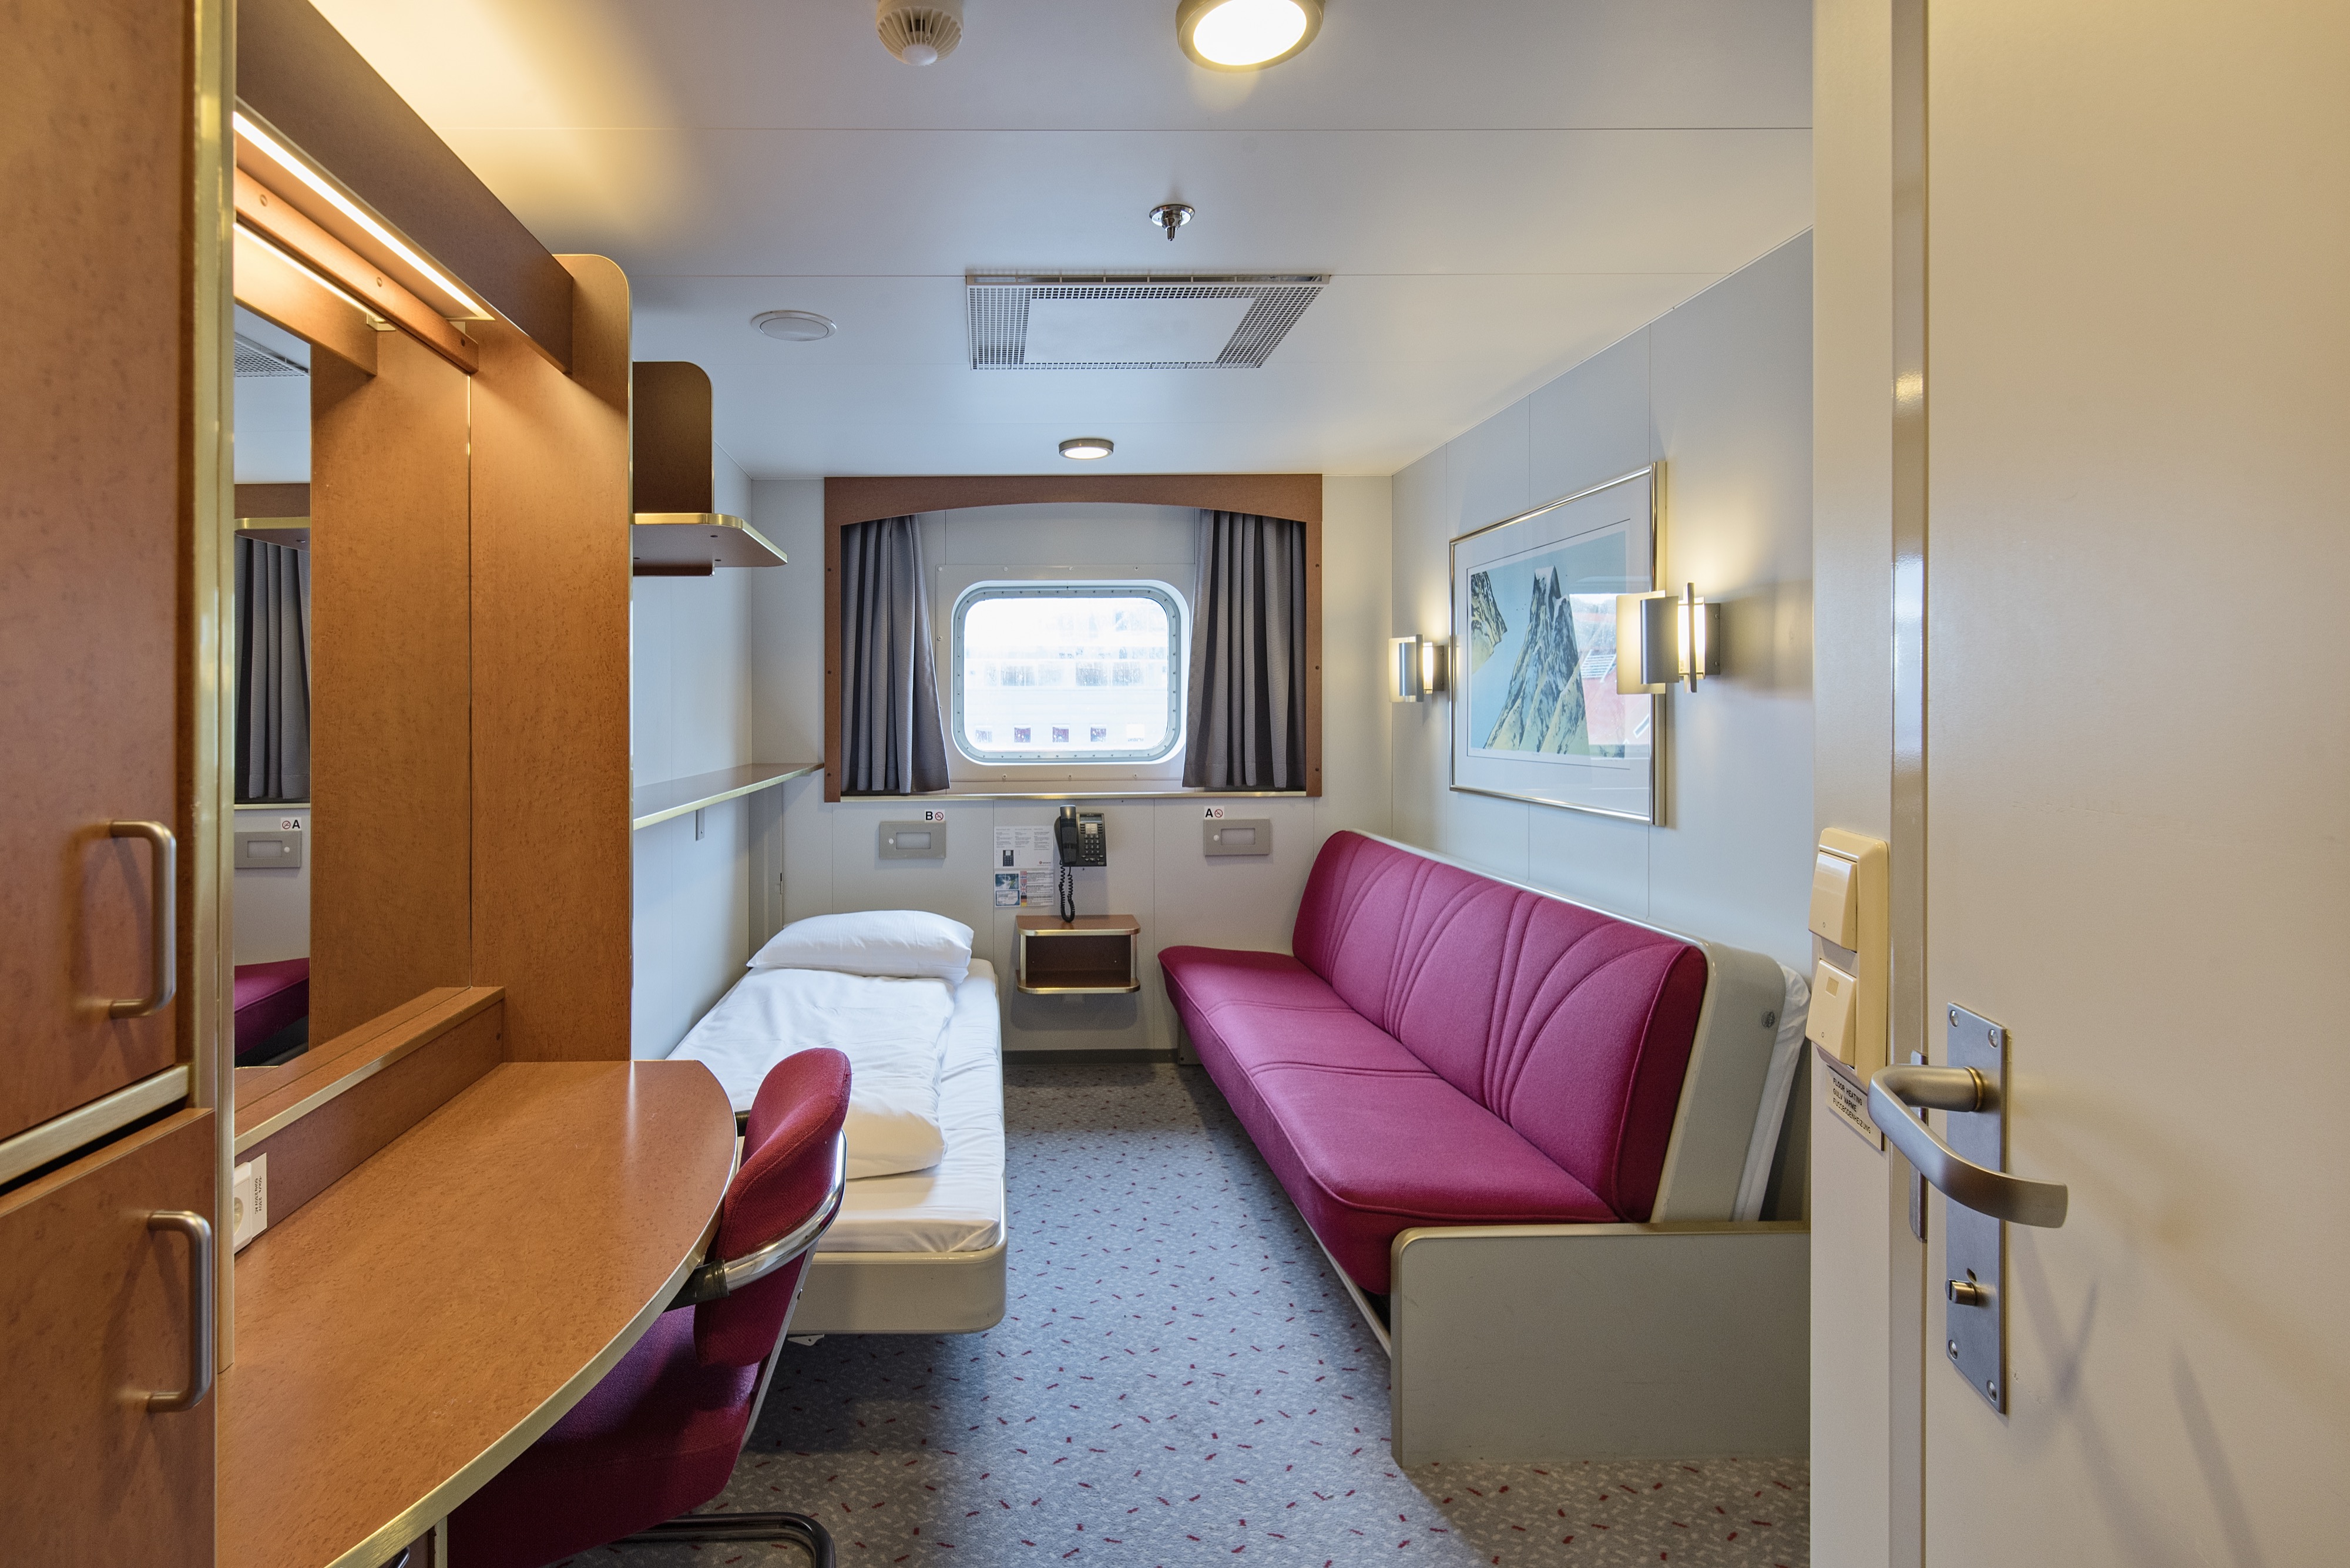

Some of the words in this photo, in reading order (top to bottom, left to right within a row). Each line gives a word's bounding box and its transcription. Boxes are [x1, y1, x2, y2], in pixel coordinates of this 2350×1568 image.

[926, 811, 933, 820] B
[1205, 808, 1213, 817] A
[1833, 1078, 1845, 1092] FLOOR
[1847, 1088, 1862, 1106] HEATING
[1833, 1089, 1842, 1100] GULV
[1844, 1096, 1856, 1112] VARME
[1833, 1098, 1871, 1134] FUSSBODENHEIZUNG
